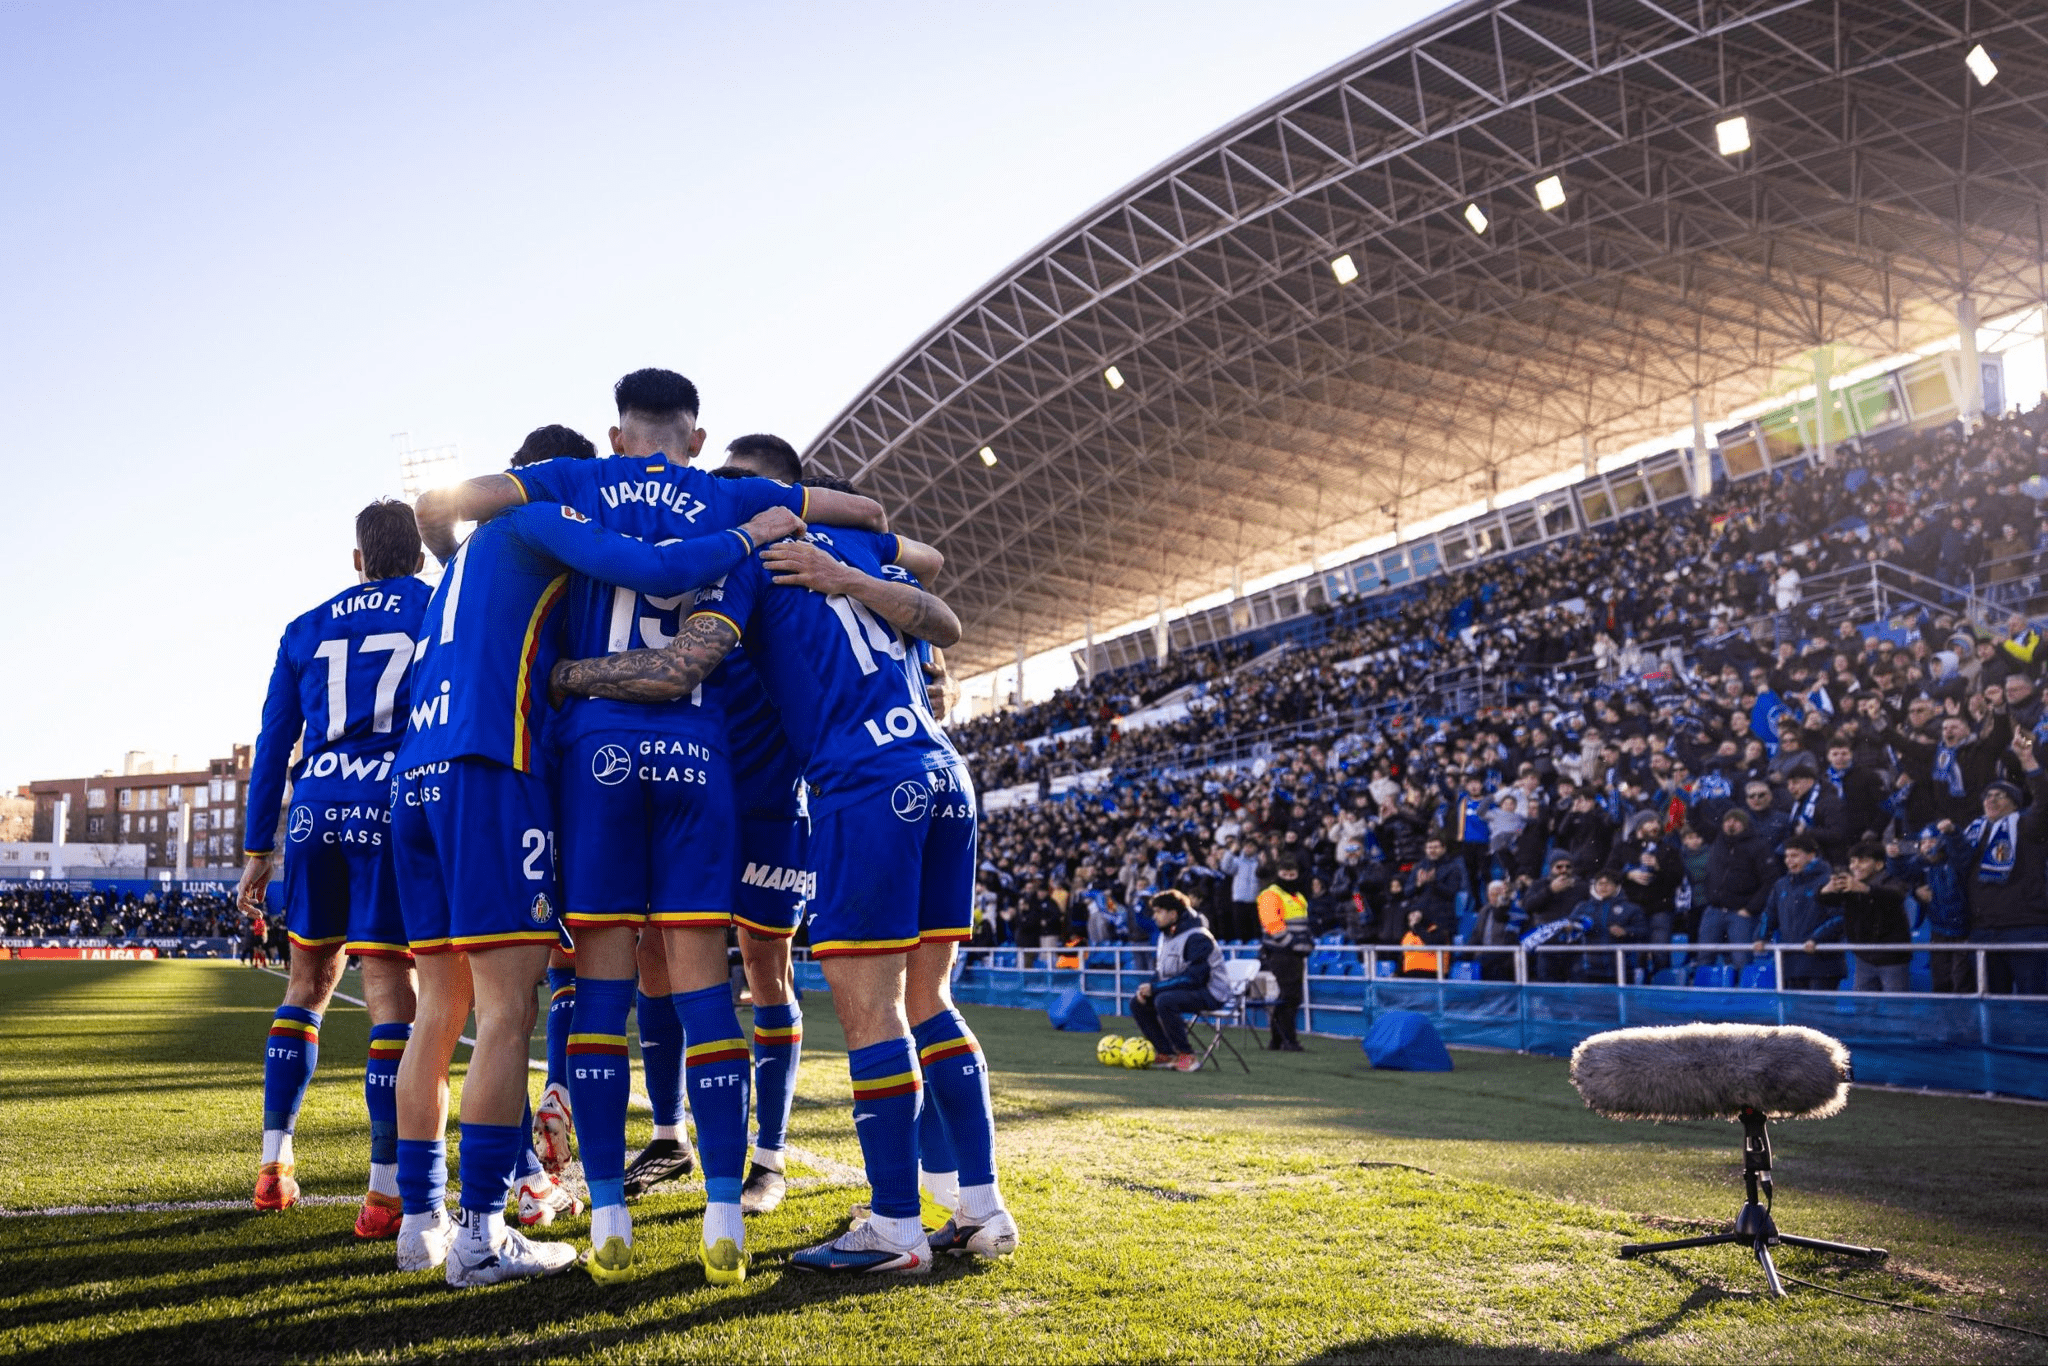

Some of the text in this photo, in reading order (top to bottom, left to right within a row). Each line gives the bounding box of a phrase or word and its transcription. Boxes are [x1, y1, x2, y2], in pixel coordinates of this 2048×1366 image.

[600, 480, 706, 524] VAZQUEZ
[331, 592, 402, 619] KIKO F.
[313, 632, 416, 742] 17
[640, 740, 710, 762] GRAND
[638, 766, 707, 785] CLASS
[405, 786, 441, 807] CSS
[931, 804, 975, 818] CASS
[741, 862, 807, 895] MAPE
[268, 1047, 299, 1060] GTF
[575, 1068, 616, 1080] GTF
[962, 1062, 987, 1076] GT
[368, 1072, 398, 1088] GTF
[699, 1073, 740, 1089] GTF
